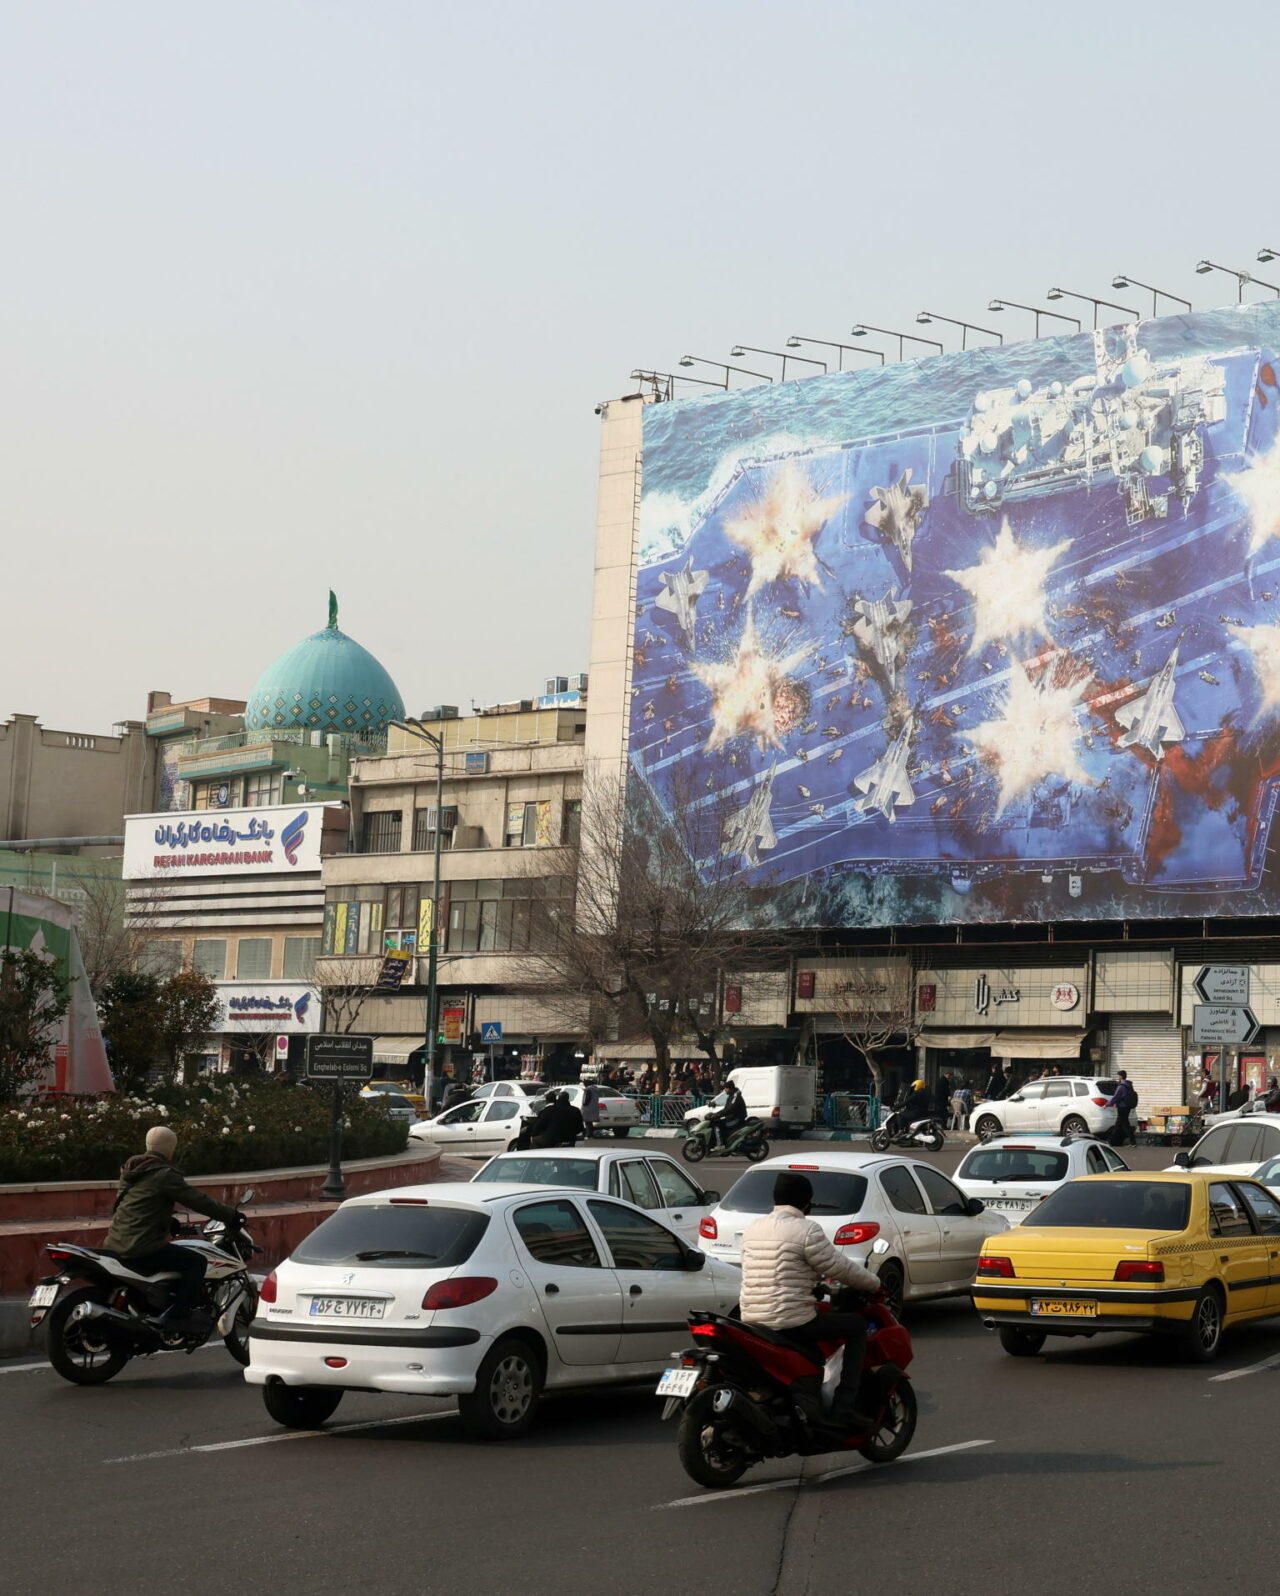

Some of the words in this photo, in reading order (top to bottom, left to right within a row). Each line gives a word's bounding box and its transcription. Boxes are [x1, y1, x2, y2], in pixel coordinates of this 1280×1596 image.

[155, 820, 202, 849] کارگران
[201, 819, 236, 846] رفاه
[237, 818, 274, 846] بانک
[154, 855, 186, 868] REFAH
[187, 852, 243, 866] KARGARAN
[244, 850, 273, 864] BANK
[993, 988, 1020, 1005] کفش
[315, 1040, 334, 1050] اسلامی
[352, 1041, 367, 1050] میدان
[318, 1300, 332, 1314] ۵۶
[334, 1299, 344, 1314] ج
[346, 1301, 367, 1315] ۷۷۴
[369, 1304, 381, 1316] ۴۰
[1063, 1302, 1080, 1312] ۹۸۶
